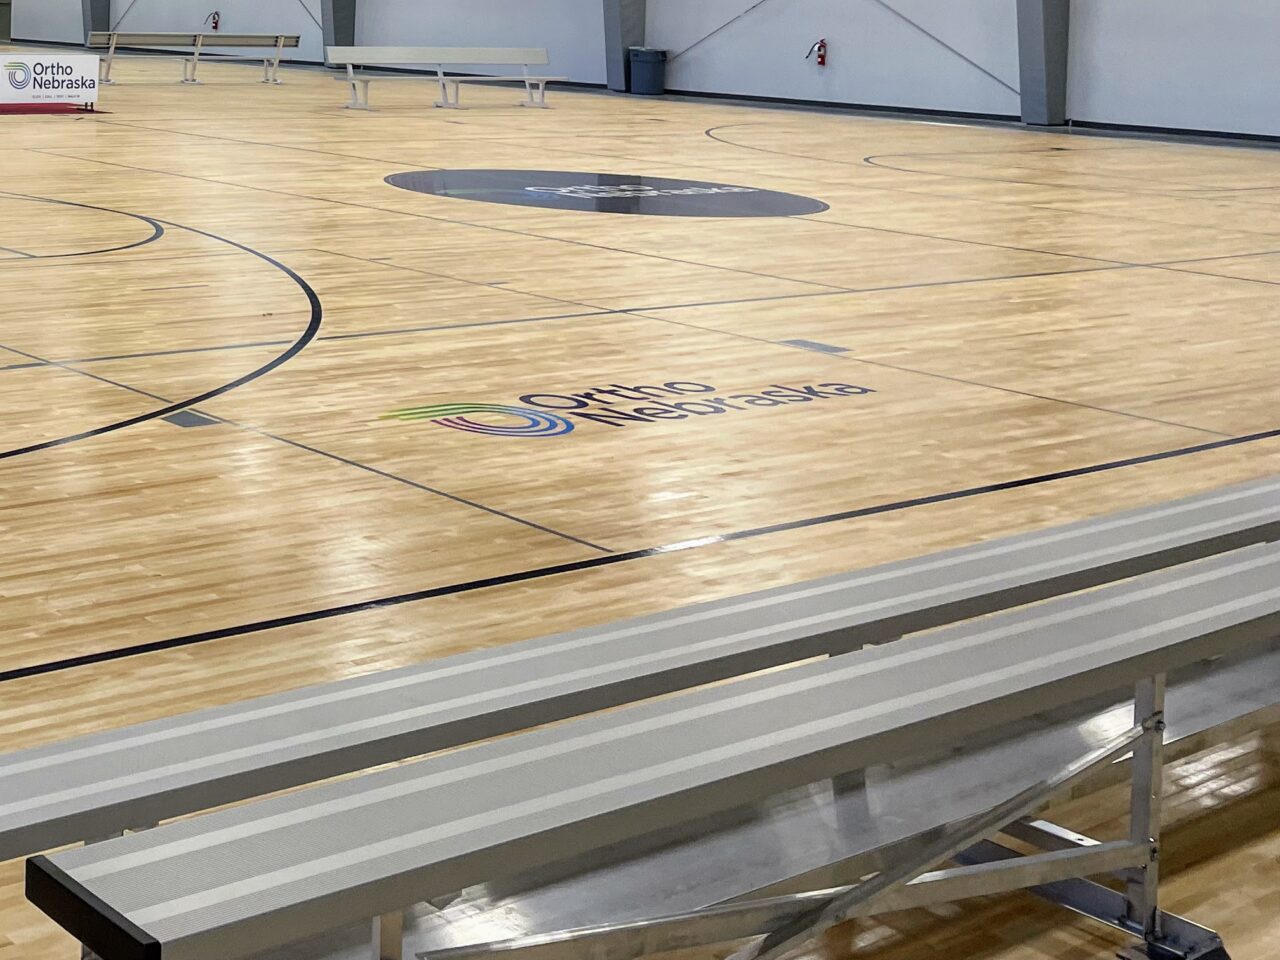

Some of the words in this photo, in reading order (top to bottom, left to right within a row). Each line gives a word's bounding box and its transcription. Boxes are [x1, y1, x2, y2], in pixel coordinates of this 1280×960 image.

[33, 62, 73, 76] Ortho
[33, 76, 96, 90] Nebraska
[519, 381, 716, 410] Ortho
[568, 382, 878, 427] Nebraska
